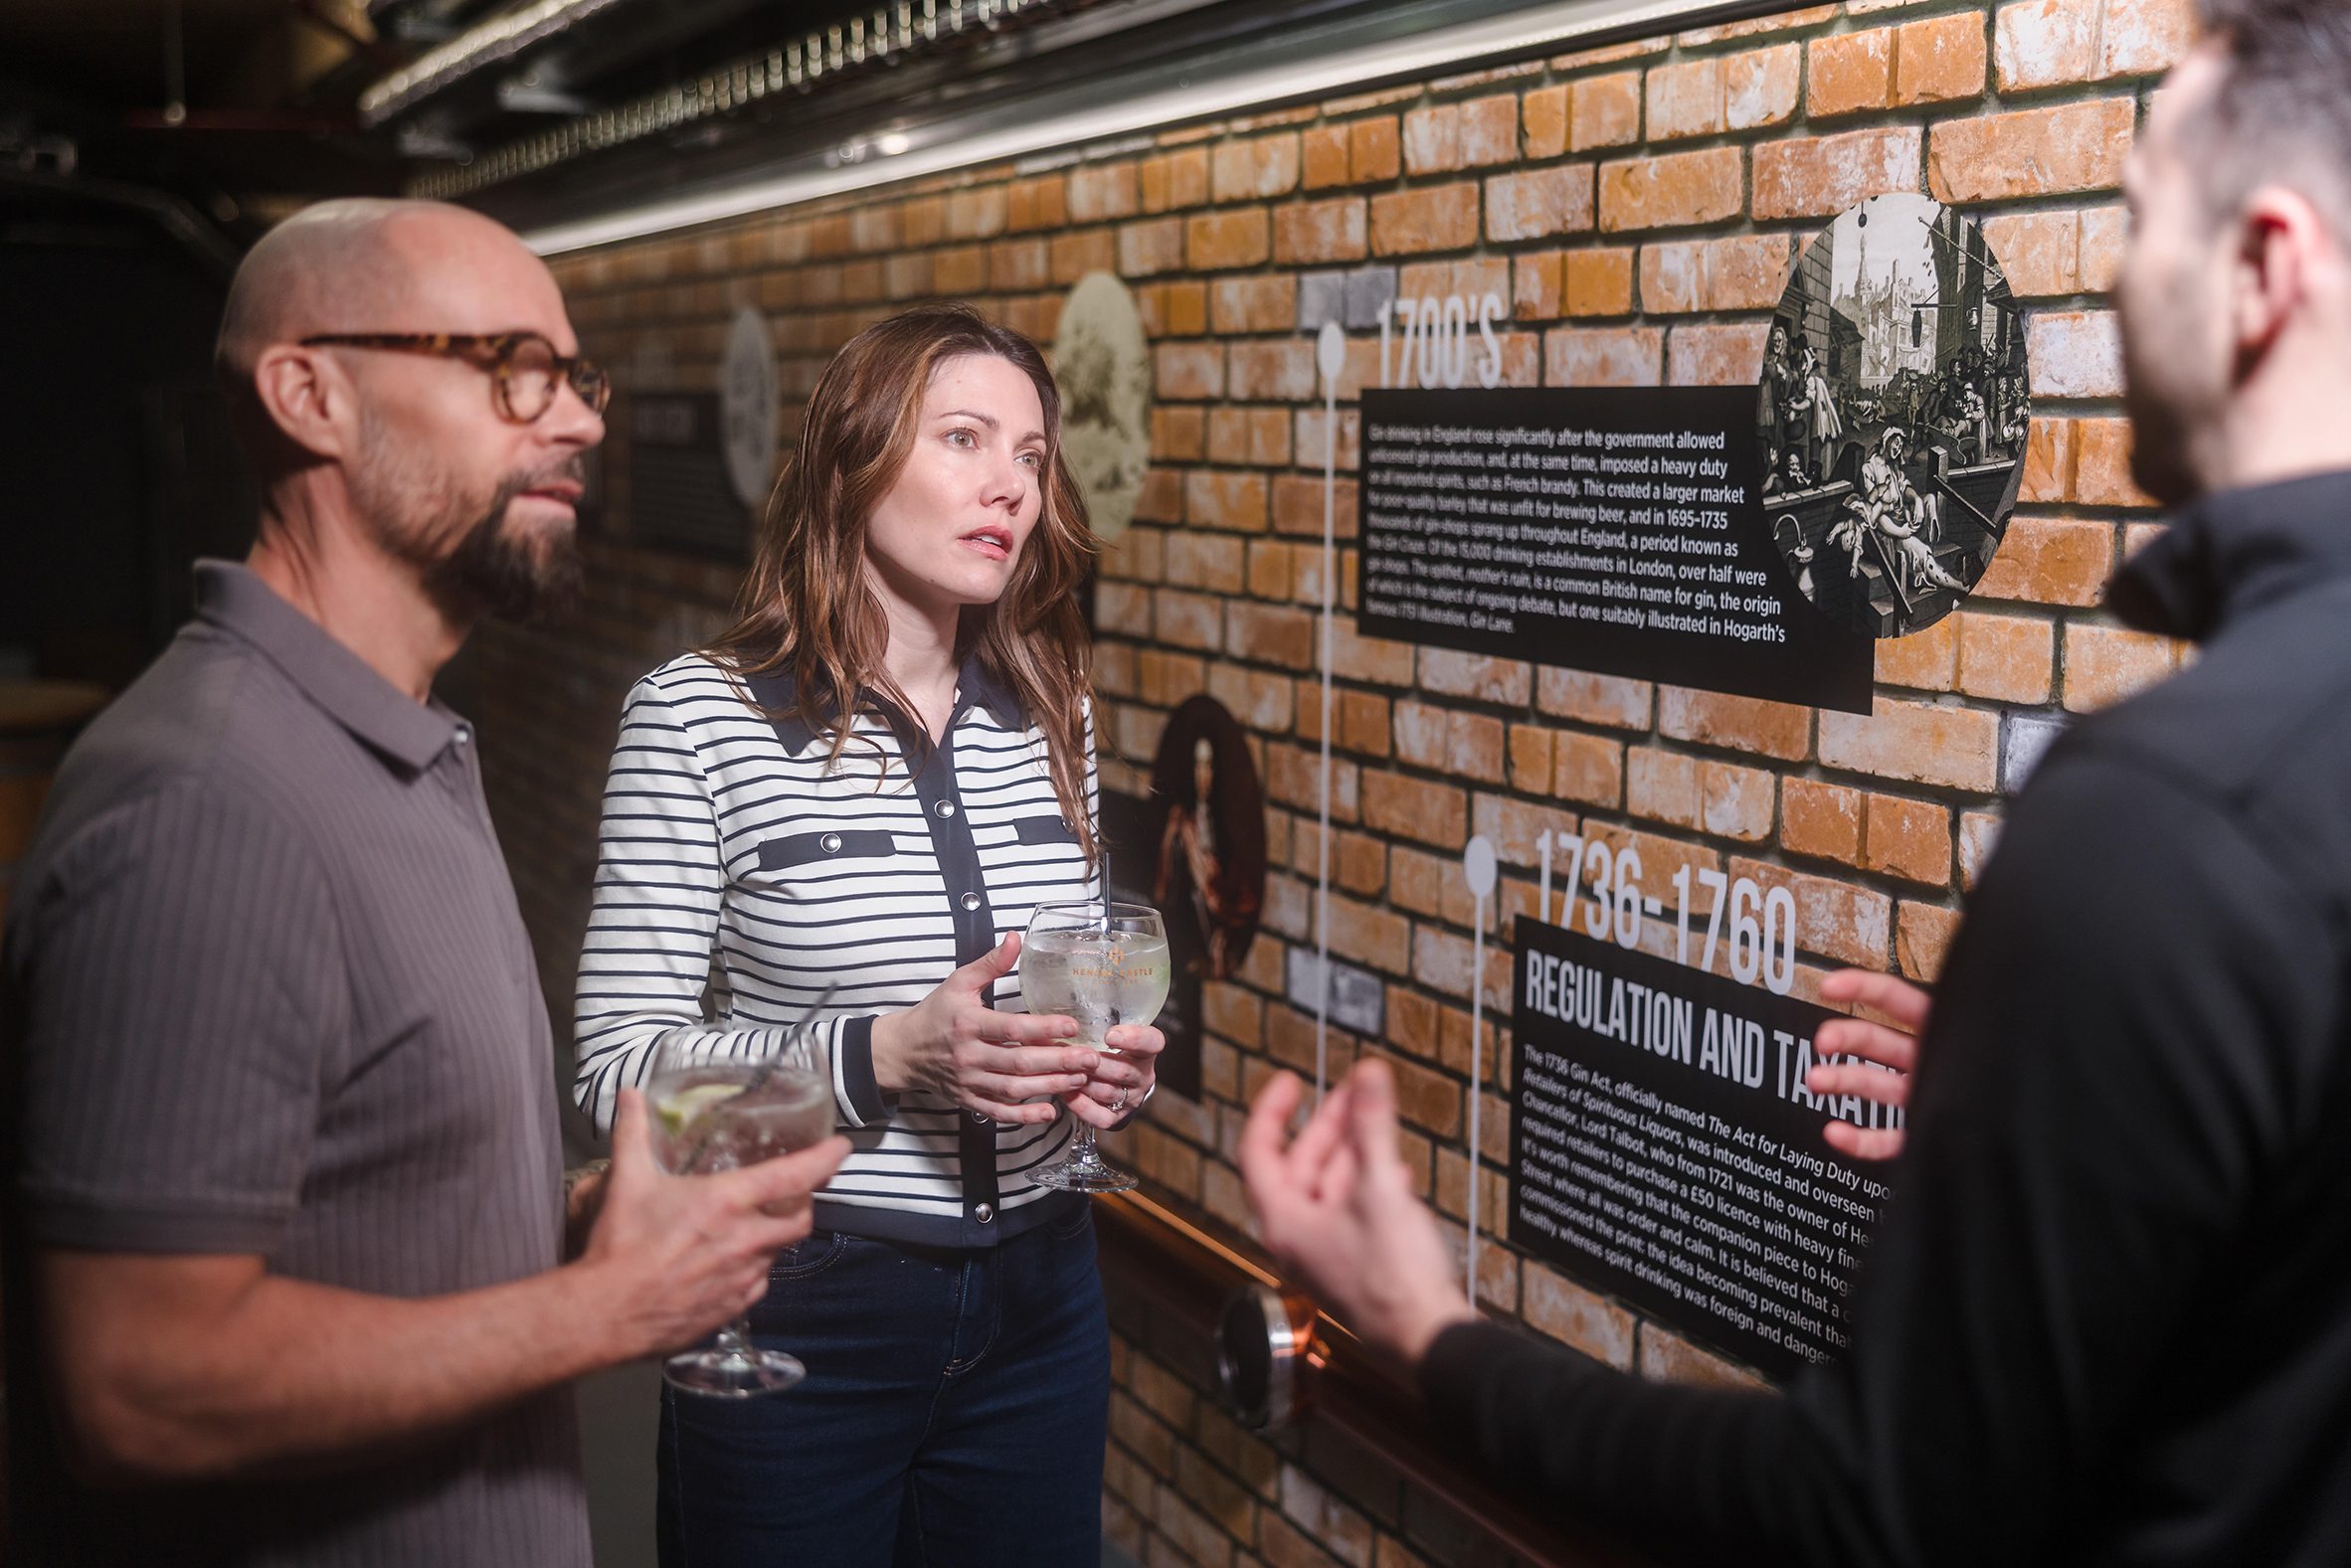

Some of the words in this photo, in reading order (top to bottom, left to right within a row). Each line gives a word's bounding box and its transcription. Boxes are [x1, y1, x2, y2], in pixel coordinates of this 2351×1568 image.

[1376, 294, 1507, 390] 1700'S
[1540, 455, 1569, 470] same
[1599, 454, 1649, 475] imposed
[1650, 459, 1659, 474] a
[1660, 455, 1698, 478] heavy
[1699, 456, 1728, 479] duty
[1556, 428, 1583, 446] after
[1584, 429, 1603, 447] the
[1604, 431, 1675, 450] government
[1676, 430, 1724, 449] allowed
[1582, 477, 1606, 497] This
[1606, 481, 1651, 499] created
[1652, 484, 1661, 500] a
[1662, 481, 1699, 504] larger
[1700, 484, 1744, 504] market
[1520, 523, 1579, 546] throughout
[1580, 527, 1629, 550] England,
[1629, 534, 1639, 550] a
[1639, 533, 1679, 553] period
[1681, 534, 1721, 556] known
[1723, 542, 1738, 557] as
[1535, 499, 1551, 518] for
[1552, 501, 1597, 524] brewing
[1598, 504, 1627, 525] beer,
[1628, 506, 1652, 525] and
[1653, 507, 1665, 525] in
[1535, 550, 1614, 573] establishments
[1615, 555, 1627, 573] in
[1629, 557, 1677, 581] London,
[1678, 564, 1707, 581] over
[1709, 563, 1732, 583] half
[1734, 570, 1767, 587] were
[1533, 573, 1543, 590] is
[1542, 576, 1552, 591] a
[1552, 577, 1600, 596] common
[1601, 579, 1638, 600] British
[1639, 587, 1673, 604] name
[1674, 586, 1693, 606] for
[1694, 589, 1718, 610] gin,
[1719, 591, 1740, 610] the
[1742, 594, 1781, 617] origin
[1557, 599, 1578, 617] but
[1578, 605, 1600, 620] one
[1601, 605, 1646, 629] suitably
[1647, 609, 1708, 633] illustrated
[1709, 615, 1721, 635] in
[1723, 617, 1785, 643] Hogarth's
[1536, 828, 1797, 995] 1736-1760
[1525, 949, 1694, 1067] REGULATION
[1699, 1007, 1764, 1092] AND
[1568, 1088, 1582, 1104] of
[1581, 1091, 1637, 1128] Spirituous
[1638, 1114, 1685, 1148] Liquors,
[1687, 1135, 1711, 1157] was
[1713, 1141, 1781, 1185] introduced
[1784, 1174, 1809, 1196] and
[1812, 1186, 1875, 1222] overseen
[1569, 1062, 1589, 1083] Gin
[1614, 1081, 1663, 1115] officially
[1664, 1102, 1706, 1130] named
[1709, 1115, 1731, 1138] The
[1731, 1126, 1756, 1148] Act
[1757, 1133, 1778, 1155] for
[1778, 1142, 1824, 1177] Laying
[1826, 1160, 1861, 1191] Duty
[1580, 1115, 1607, 1139] Lord
[1649, 1145, 1675, 1167] who
[1677, 1152, 1706, 1180] from
[1708, 1166, 1732, 1191] 1721
[1735, 1181, 1760, 1203] was
[1762, 1189, 1784, 1213] the
[1786, 1203, 1830, 1231] owner
[1832, 1221, 1848, 1239] of
[1850, 1224, 1875, 1247] He
[1553, 1177, 1587, 1202] where
[1587, 1191, 1601, 1208] all
[1602, 1199, 1625, 1220] was
[1626, 1209, 1658, 1234] order
[1659, 1224, 1683, 1246] and
[1684, 1236, 1716, 1262] calm.
[1718, 1248, 1728, 1268] It
[1730, 1253, 1741, 1273] is
[1743, 1258, 1798, 1299] believed
[1801, 1286, 1828, 1313] that
[1831, 1303, 1839, 1318] a
[1566, 1134, 1610, 1164] retailers
[1611, 1151, 1625, 1170] to
[1625, 1160, 1678, 1194] purchase
[1679, 1183, 1688, 1198] a
[1690, 1184, 1715, 1209] £50
[1717, 1195, 1760, 1229] licence
[1763, 1219, 1791, 1243] with
[1794, 1228, 1834, 1264] heavy
[1570, 1160, 1644, 1206] remembering
[1645, 1190, 1669, 1215] that
[1671, 1202, 1691, 1225] the
[1692, 1214, 1761, 1256] companion
[1763, 1245, 1799, 1273] piece
[1802, 1260, 1817, 1280] to
[1558, 1227, 1603, 1258] whereas
[1604, 1248, 1633, 1273] spirit
[1634, 1261, 1682, 1299] drinking
[1683, 1286, 1708, 1308] was
[1710, 1295, 1754, 1330] foreign
[1756, 1321, 1781, 1344] and
[1595, 1217, 1614, 1239] the
[1647, 1241, 1667, 1264] the
[1668, 1250, 1695, 1277] idea
[1696, 1263, 1757, 1309] becoming
[1759, 1297, 1822, 1337] prevalent
